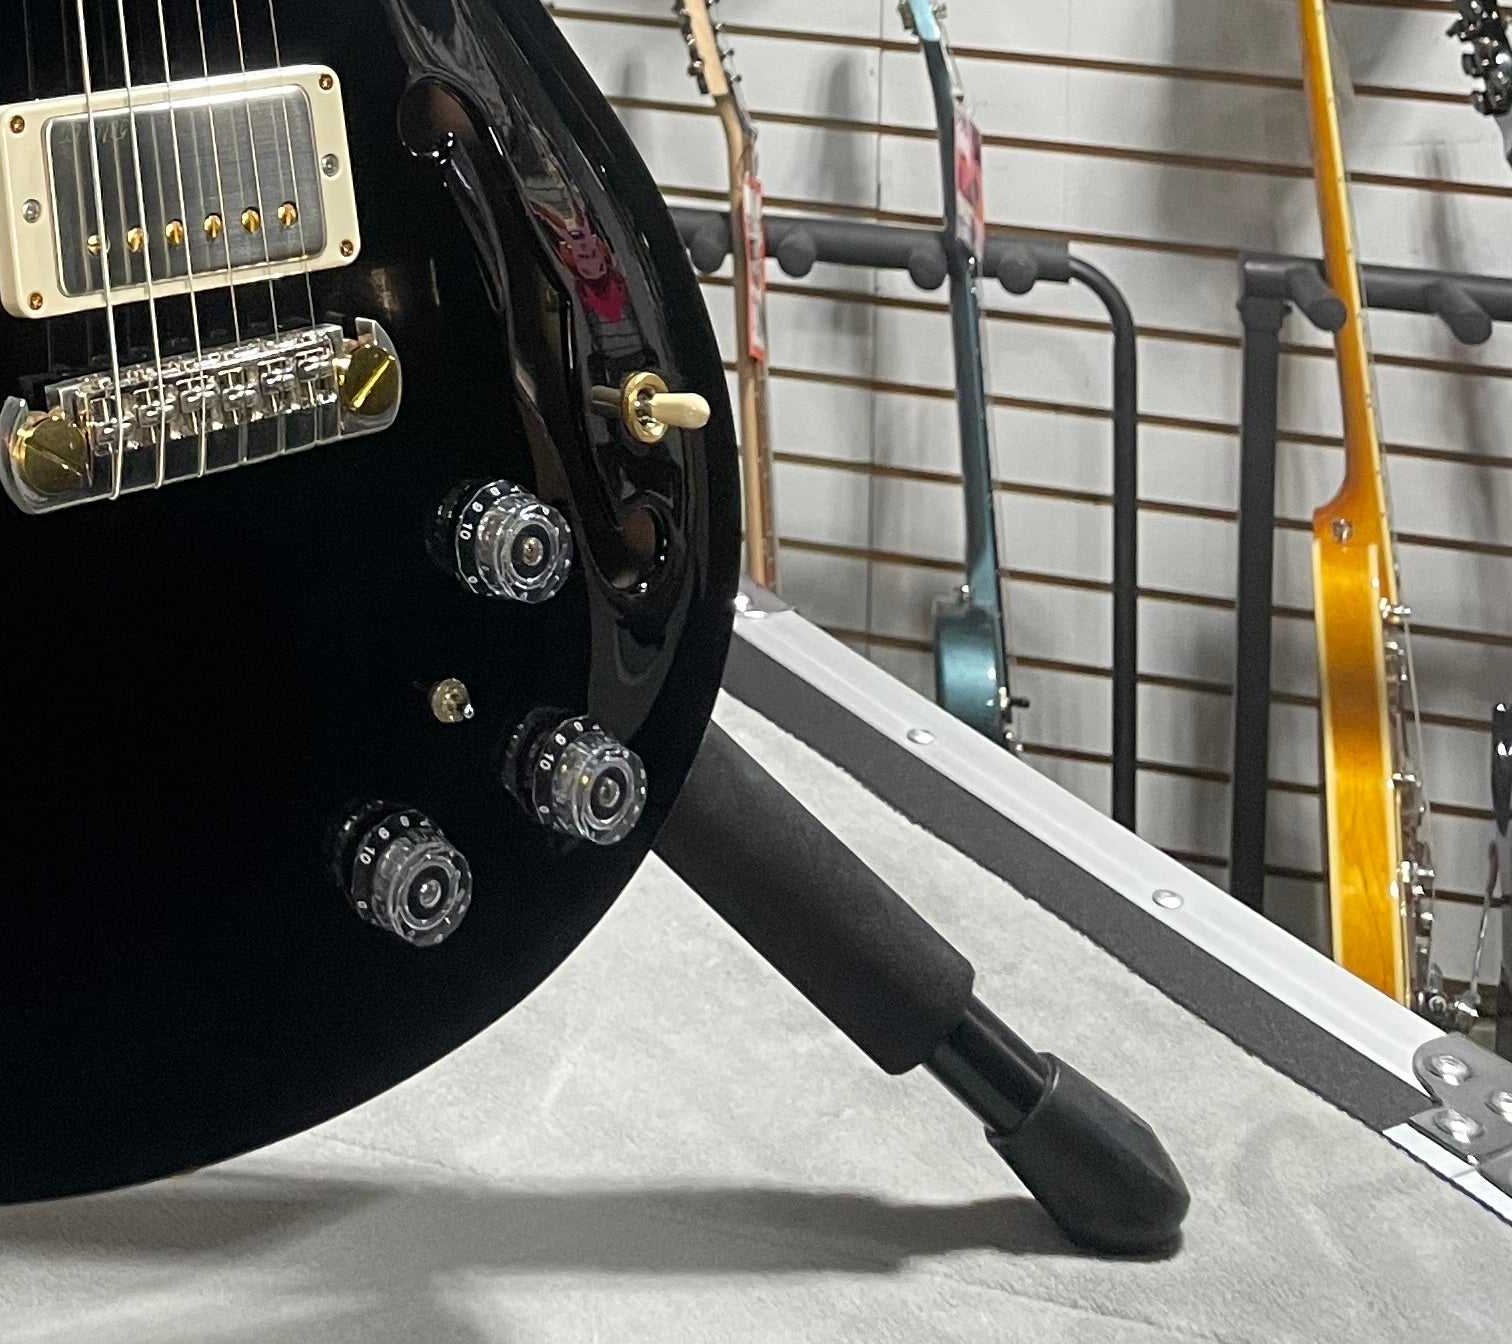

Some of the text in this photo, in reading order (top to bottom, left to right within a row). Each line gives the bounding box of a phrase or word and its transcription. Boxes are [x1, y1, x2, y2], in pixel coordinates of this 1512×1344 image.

[459, 522, 474, 541] 10
[539, 752, 555, 771] 10
[359, 845, 376, 865] 10
